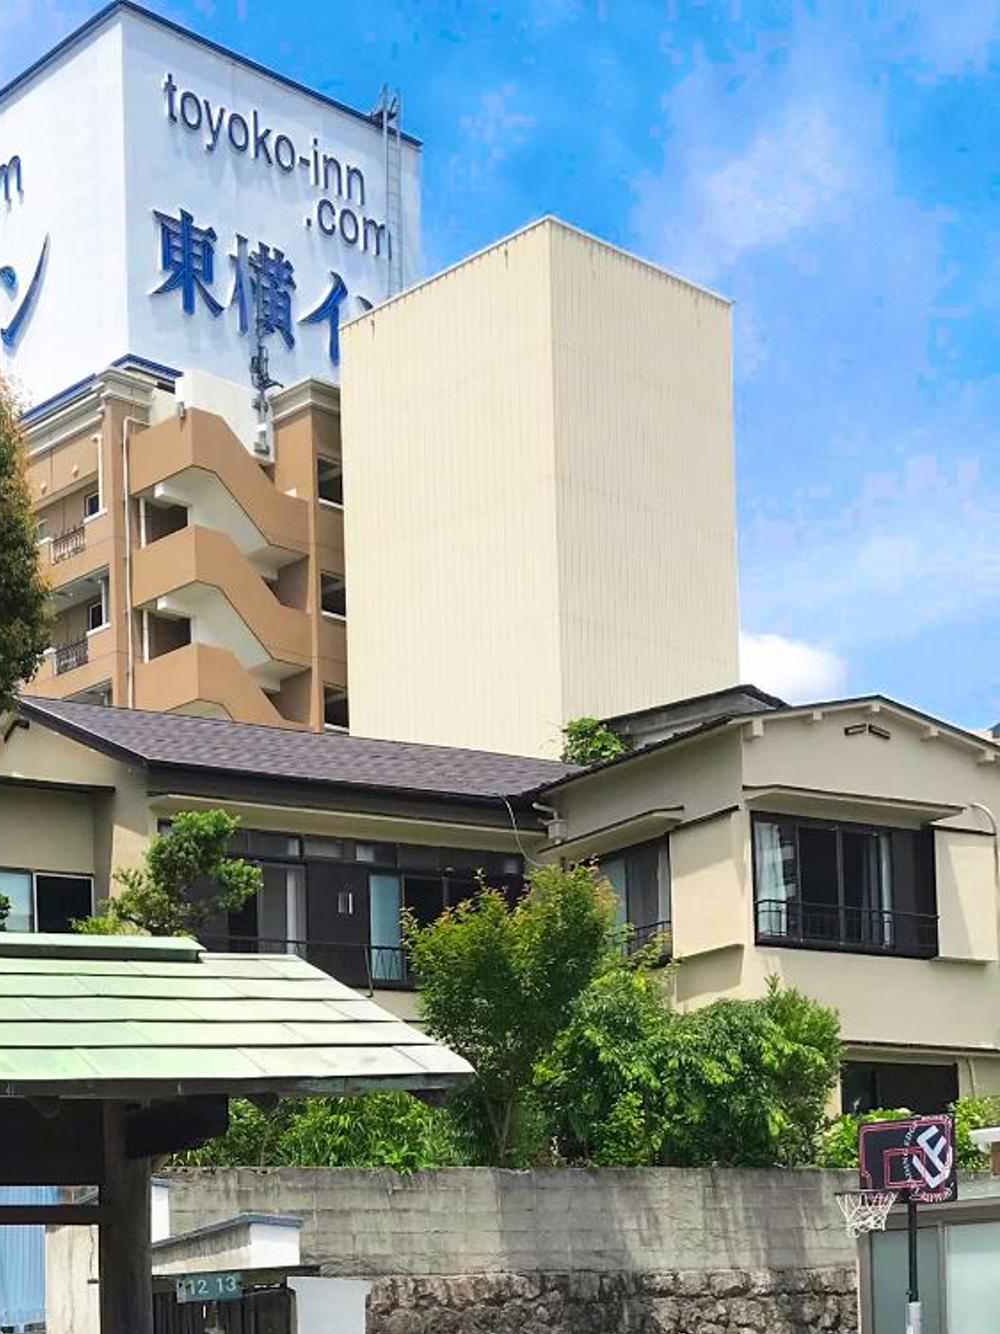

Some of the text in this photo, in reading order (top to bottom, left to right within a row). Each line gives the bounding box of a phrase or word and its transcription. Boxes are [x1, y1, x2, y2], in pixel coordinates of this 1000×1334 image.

[164, 73, 366, 206] toyoko-inn
[147, 207, 374, 368] 東横イ
[216, 1276, 237, 1293] 13
